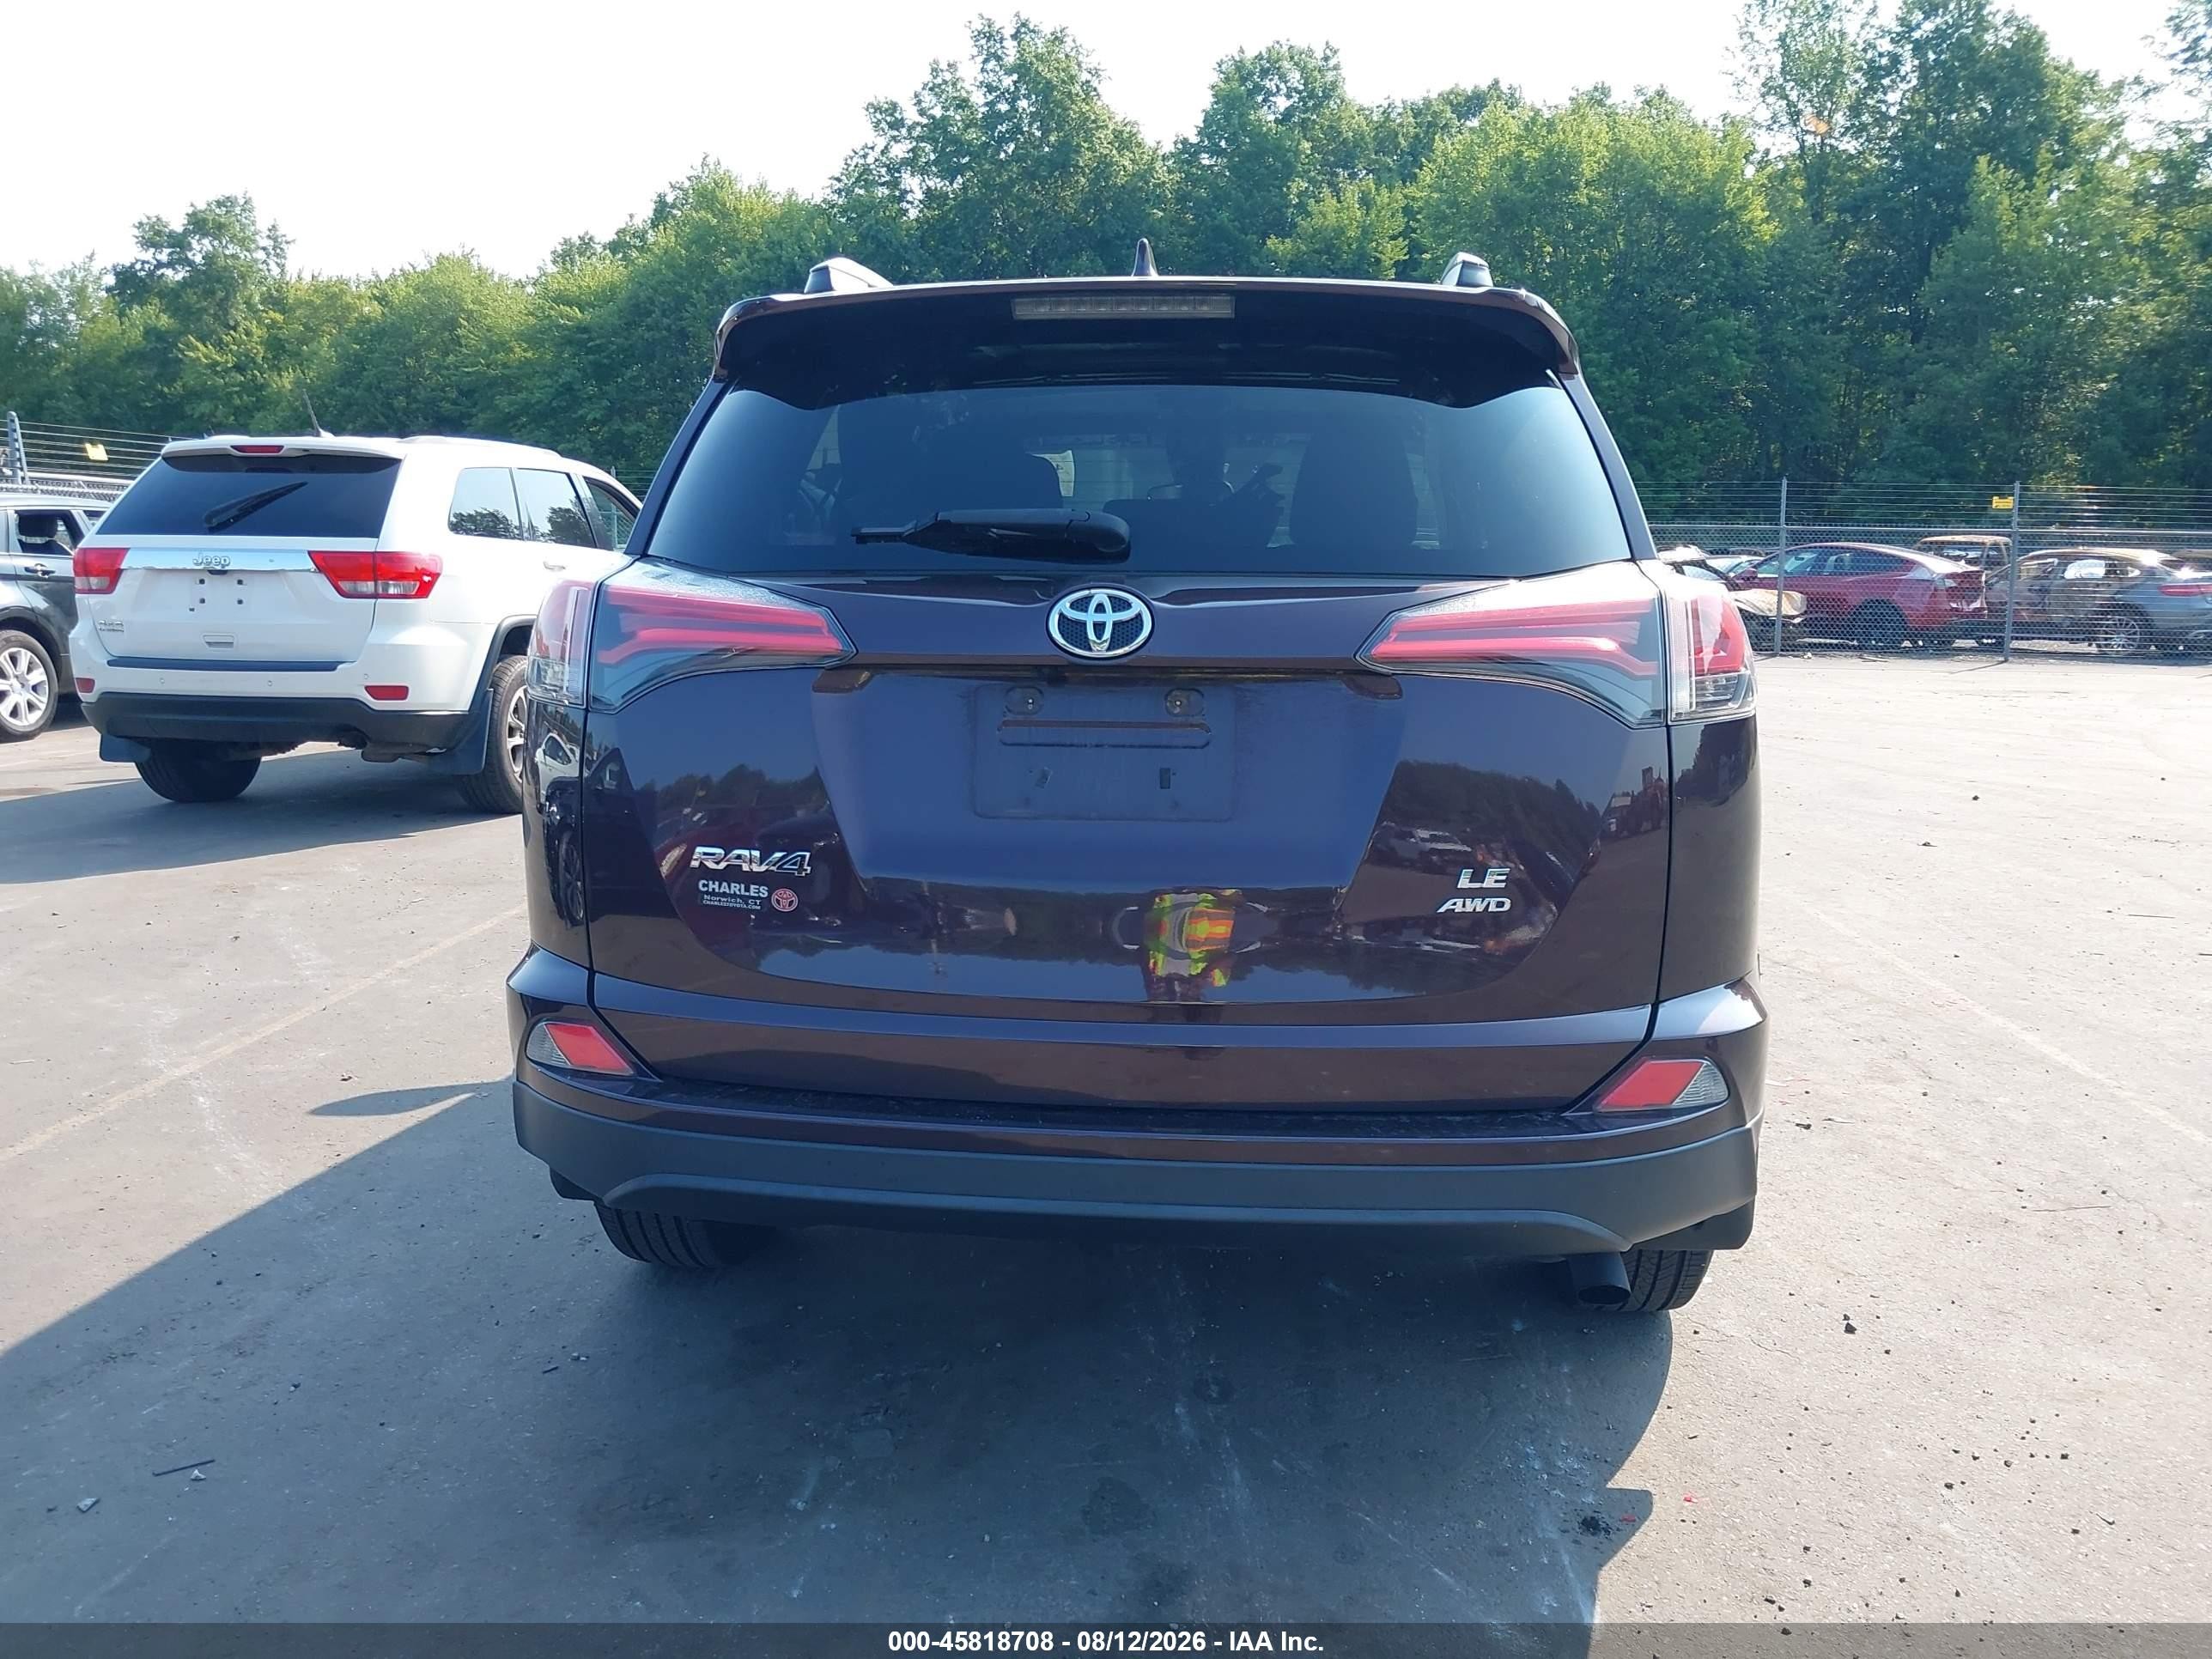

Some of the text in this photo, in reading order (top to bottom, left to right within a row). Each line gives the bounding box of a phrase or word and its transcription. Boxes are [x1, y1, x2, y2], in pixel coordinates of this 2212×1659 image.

[192, 553, 231, 568] Jeep
[690, 846, 811, 877] RAV4
[1457, 868, 1510, 888] LE
[698, 879, 769, 898] CHARLES
[704, 894, 744, 904] Norwich,
[1437, 897, 1511, 913] AWD
